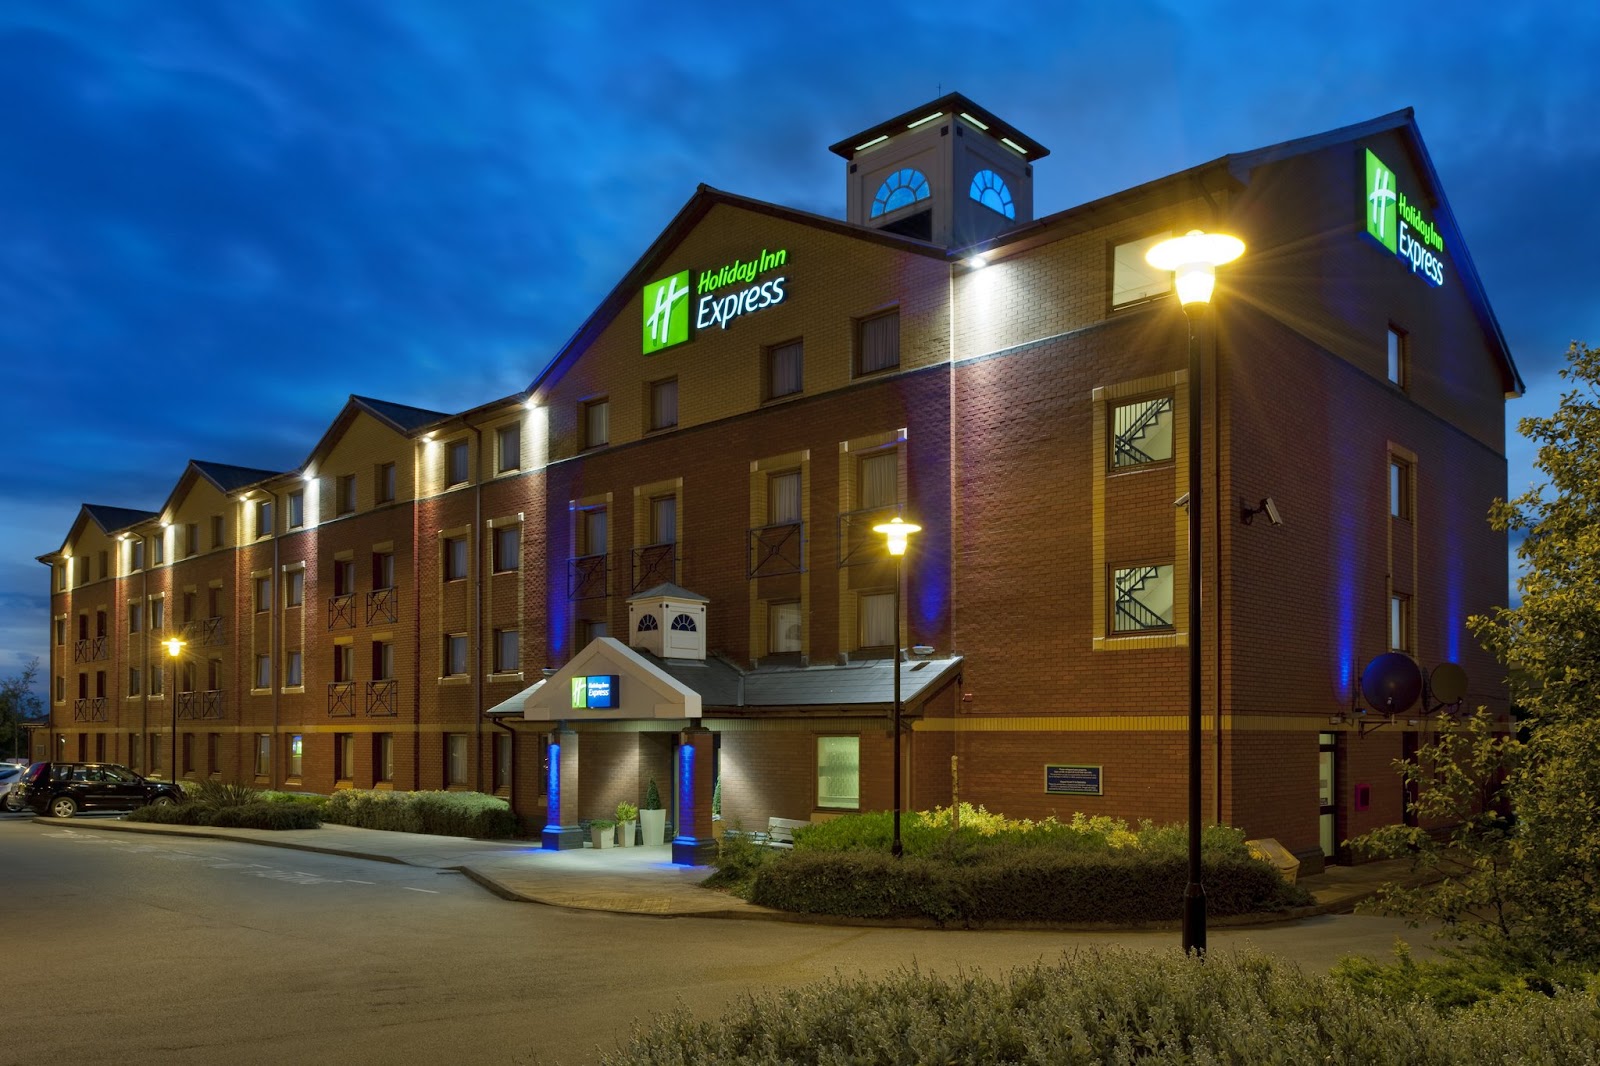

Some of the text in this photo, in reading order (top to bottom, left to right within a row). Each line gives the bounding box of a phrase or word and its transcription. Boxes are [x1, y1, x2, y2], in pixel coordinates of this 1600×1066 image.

[1399, 192, 1443, 252] Holiday Inn
[697, 249, 786, 294] Holiday Inn
[1399, 220, 1443, 285] Express
[697, 277, 785, 328] Express
